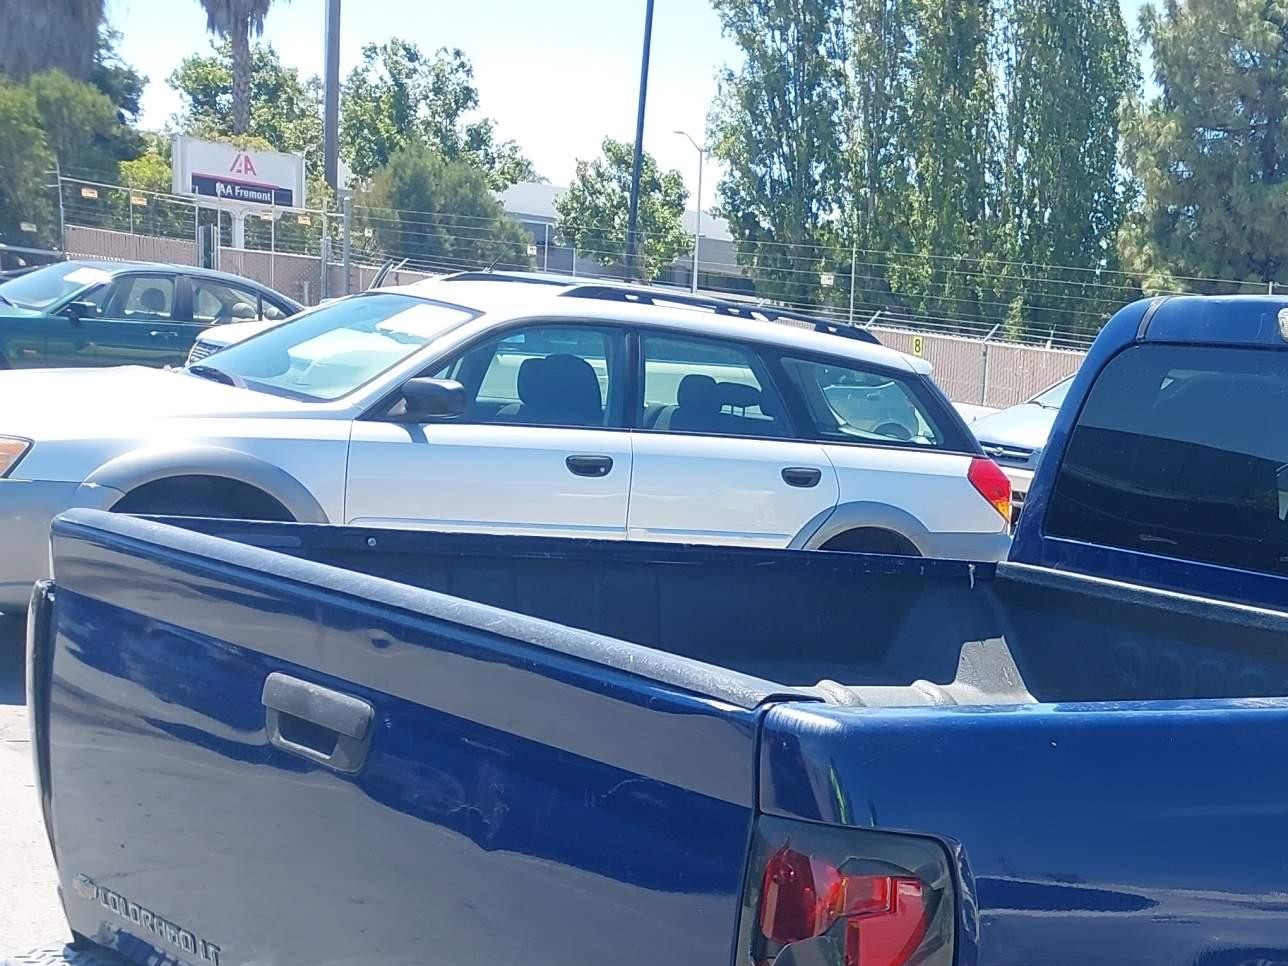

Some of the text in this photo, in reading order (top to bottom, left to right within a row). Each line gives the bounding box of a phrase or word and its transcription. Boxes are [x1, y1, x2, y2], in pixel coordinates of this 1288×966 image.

[234, 186, 271, 201] Fremont
[914, 338, 921, 353] 8
[99, 886, 221, 966] COLORADO LT
